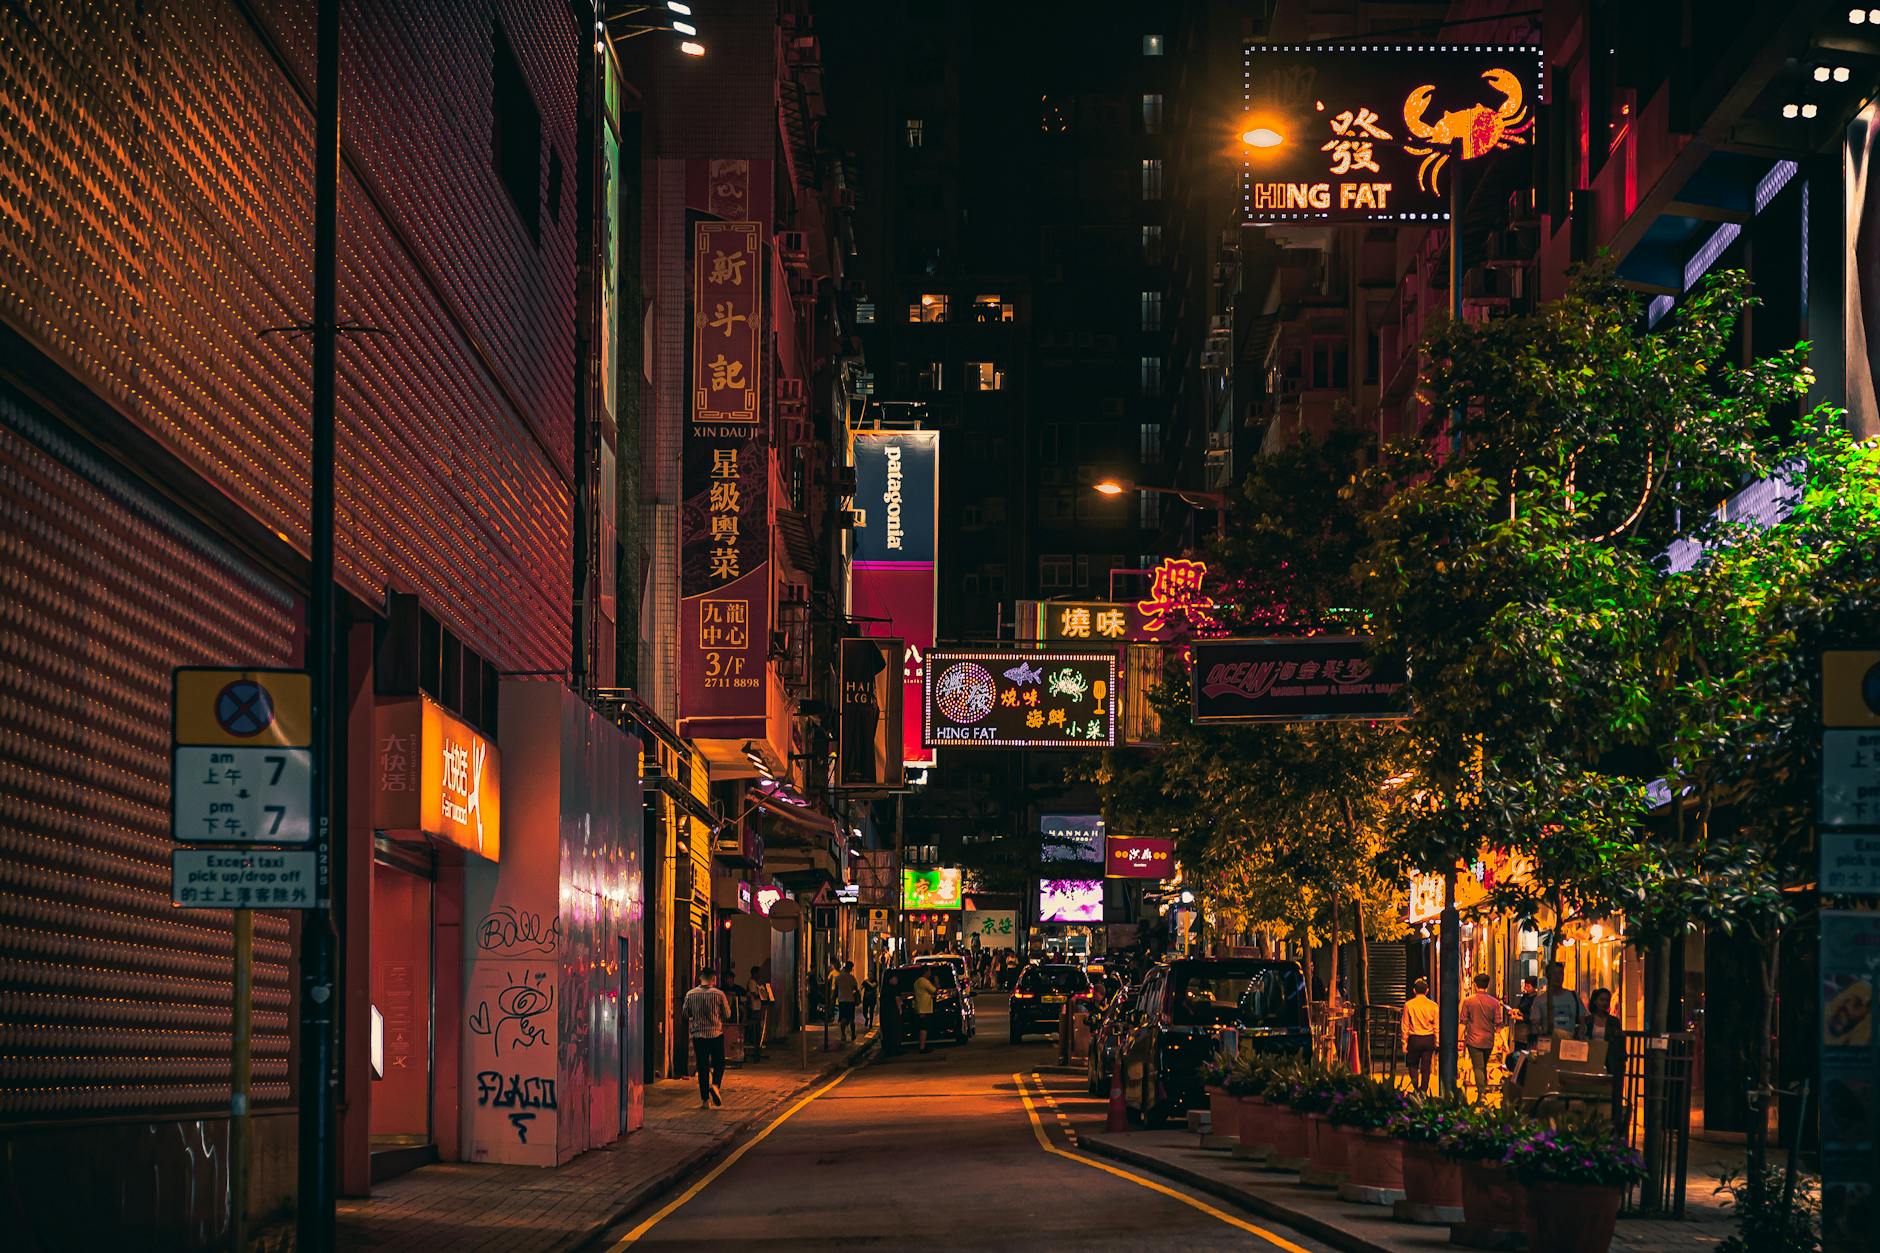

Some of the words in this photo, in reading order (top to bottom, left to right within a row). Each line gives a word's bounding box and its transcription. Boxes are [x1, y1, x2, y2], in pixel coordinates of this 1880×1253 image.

[1254, 182, 1332, 209] HING
[1339, 182, 1394, 209] FAT
[708, 250, 747, 392] 新斗記
[693, 426, 716, 438] XIN
[719, 426, 747, 438] DAU
[747, 426, 759, 440] JI
[884, 446, 904, 550] patagonia
[703, 603, 745, 624] 九龍
[1061, 607, 1126, 638] 燒味
[703, 625, 745, 645] 中心
[705, 652, 745, 676] 3/F
[704, 678, 730, 688] 2711
[733, 678, 760, 688] 8898
[1205, 661, 1276, 692] OCEAN
[936, 727, 970, 739] HING
[973, 727, 997, 739] FAT
[210, 753, 234, 763] am
[381, 733, 408, 791] 大快活
[442, 738, 468, 797] 大快活
[202, 768, 242, 785] 上午
[264, 756, 287, 785] 7
[209, 802, 234, 814] pm
[441, 792, 468, 826] Fairwood
[202, 818, 241, 834] 下午
[264, 805, 287, 835] 7
[207, 855, 254, 870] Except
[258, 856, 284, 868] taxi
[188, 871, 217, 883] pick
[222, 871, 276, 884] up/drop
[280, 871, 300, 882] off
[181, 887, 306, 902] 的士上落客除外
